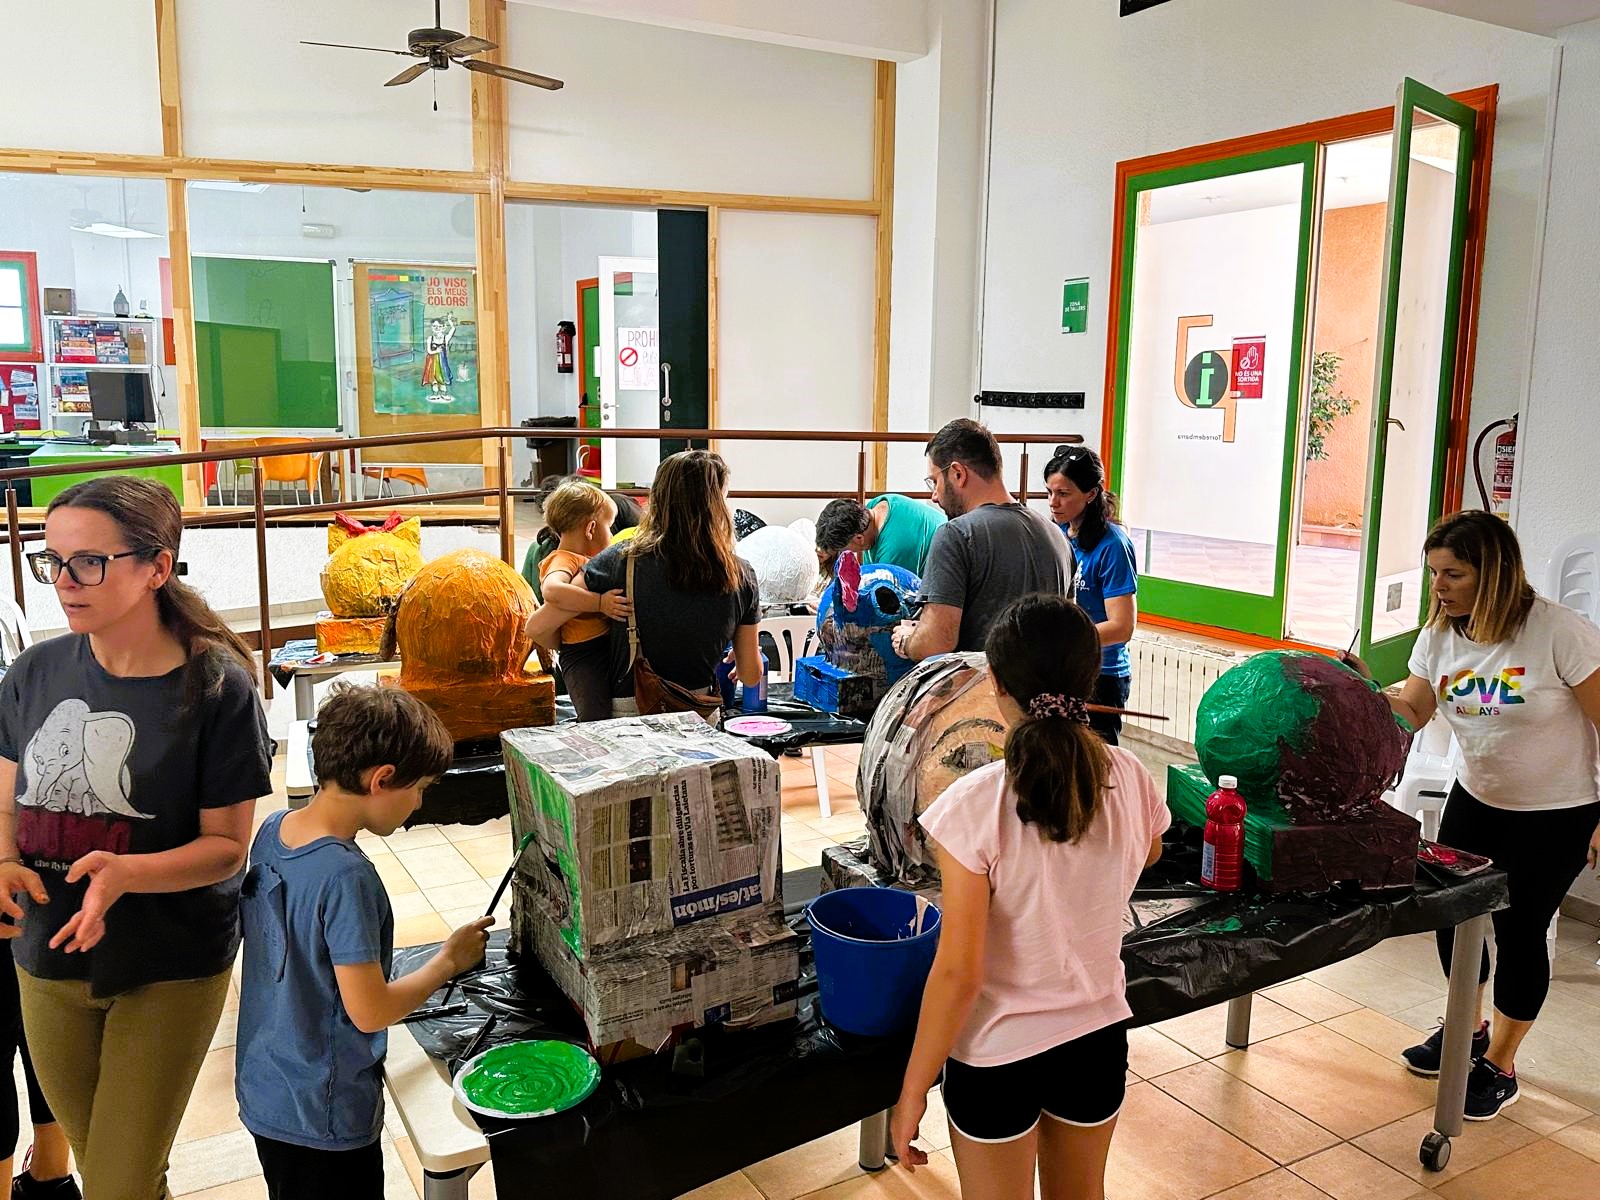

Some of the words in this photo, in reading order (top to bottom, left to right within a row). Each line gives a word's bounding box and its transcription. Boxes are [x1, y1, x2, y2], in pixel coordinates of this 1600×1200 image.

[427, 277, 440, 287] JO
[444, 277, 467, 287] VISC
[445, 288, 467, 296] MEUS
[427, 296, 468, 307] COLORS!
[627, 330, 656, 348] PROH
[1439, 667, 1526, 704] LOVE
[673, 784, 684, 830] diligencias
[678, 830, 686, 848] abre
[686, 830, 692, 840] en
[686, 842, 696, 874] torturas
[51, 861, 72, 871] flyin
[682, 882, 690, 892] La
[690, 875, 700, 890] por
[674, 884, 761, 918] at/es/món
